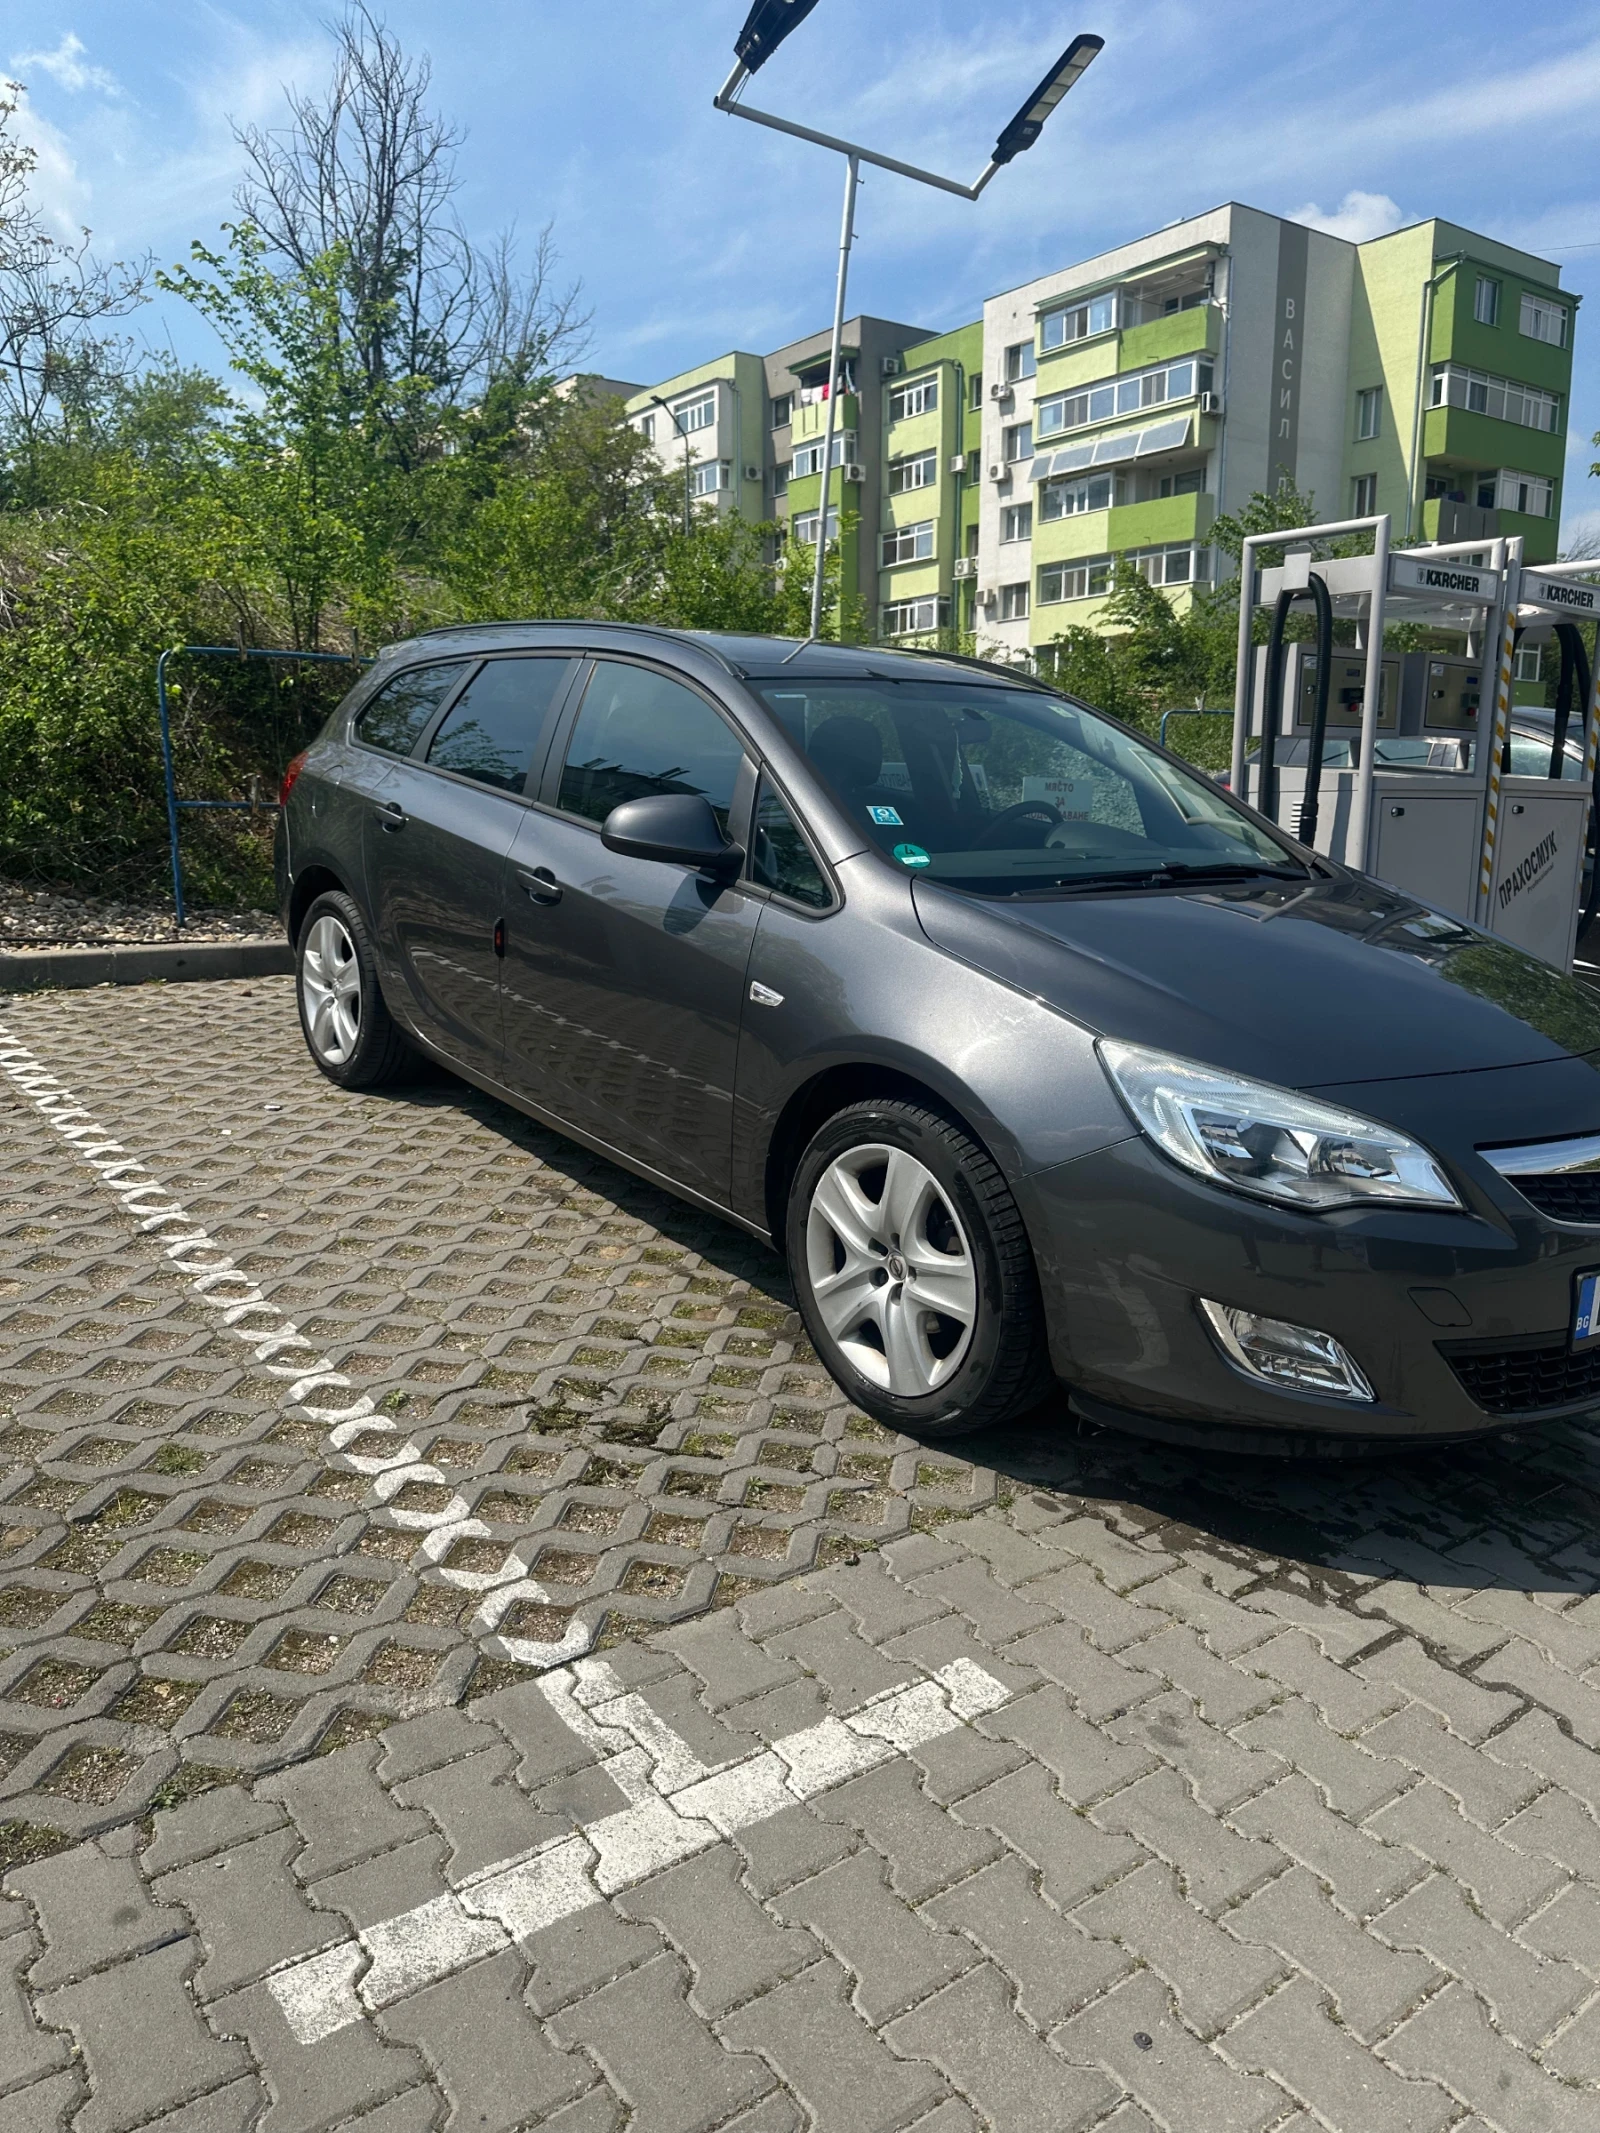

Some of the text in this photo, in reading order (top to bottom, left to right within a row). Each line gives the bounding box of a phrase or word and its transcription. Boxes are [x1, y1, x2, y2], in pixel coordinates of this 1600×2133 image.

[1278, 298, 1296, 439] ВАСИЛ
[1426, 569, 1479, 593] KÄRCHER
[1547, 585, 1594, 608] KÄRCHER
[1044, 782, 1074, 793] МЯСТО
[904, 845, 916, 856] 4
[1498, 830, 1558, 909] ПРАХОСМУК
[1576, 1315, 1589, 1331] BG
